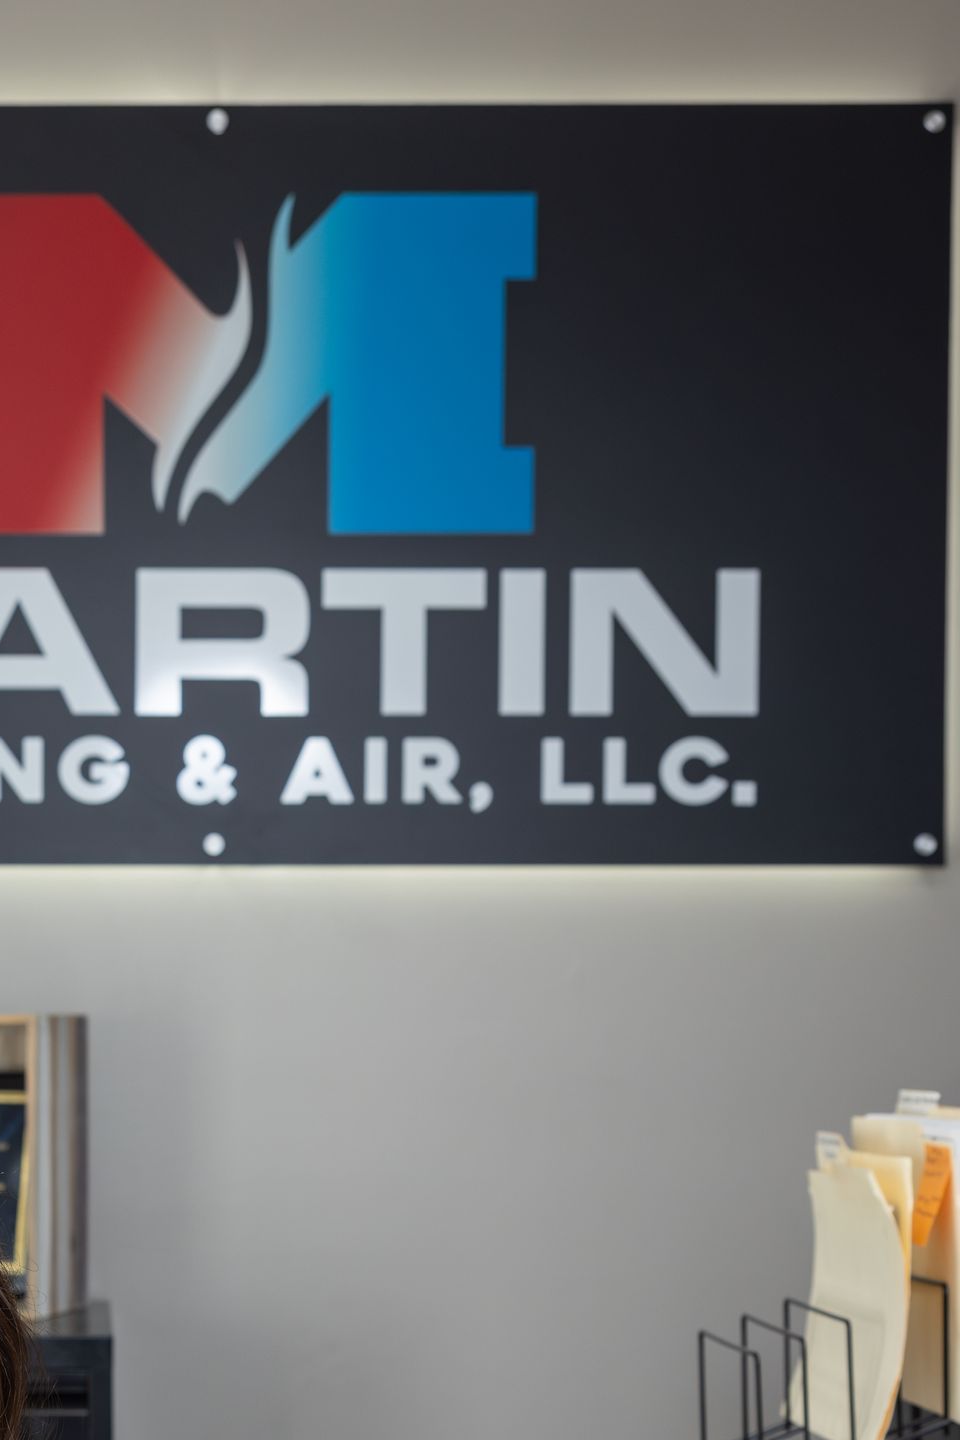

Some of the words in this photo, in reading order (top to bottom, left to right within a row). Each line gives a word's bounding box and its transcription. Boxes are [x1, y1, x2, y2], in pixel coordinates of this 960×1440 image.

[176, 734, 238, 806] &
[280, 736, 494, 814] AIR,
[539, 736, 759, 807] LLC.
